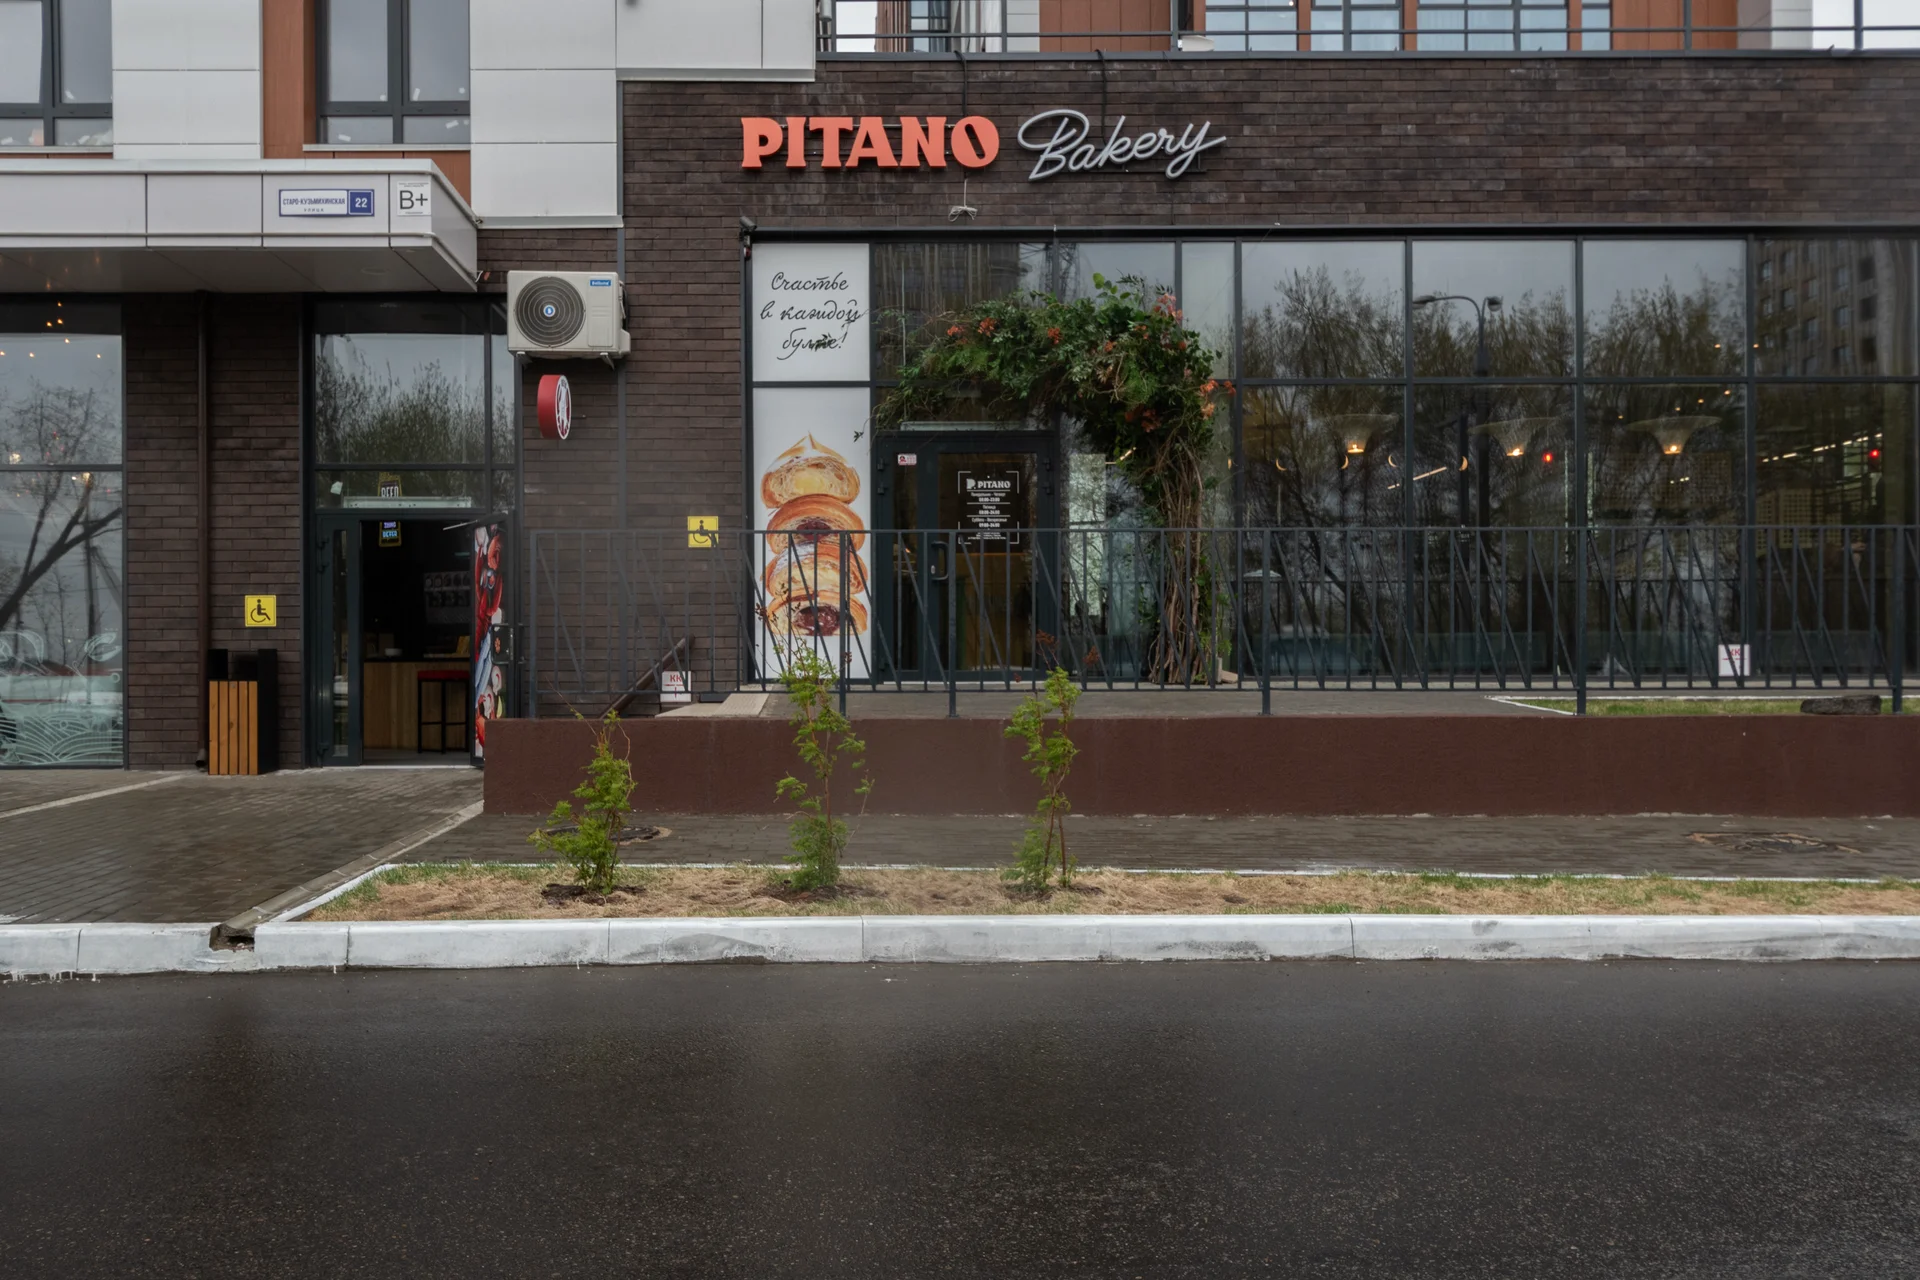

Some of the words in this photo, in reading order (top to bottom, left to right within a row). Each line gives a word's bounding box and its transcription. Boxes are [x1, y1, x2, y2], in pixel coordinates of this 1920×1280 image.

[740, 115, 999, 168] PITANO
[1016, 108, 1227, 181] Bakery
[355, 197, 368, 208] 22
[771, 271, 849, 291] Счастье
[760, 300, 776, 320] в
[780, 299, 861, 321] каждой
[978, 480, 1010, 488] PITANO
